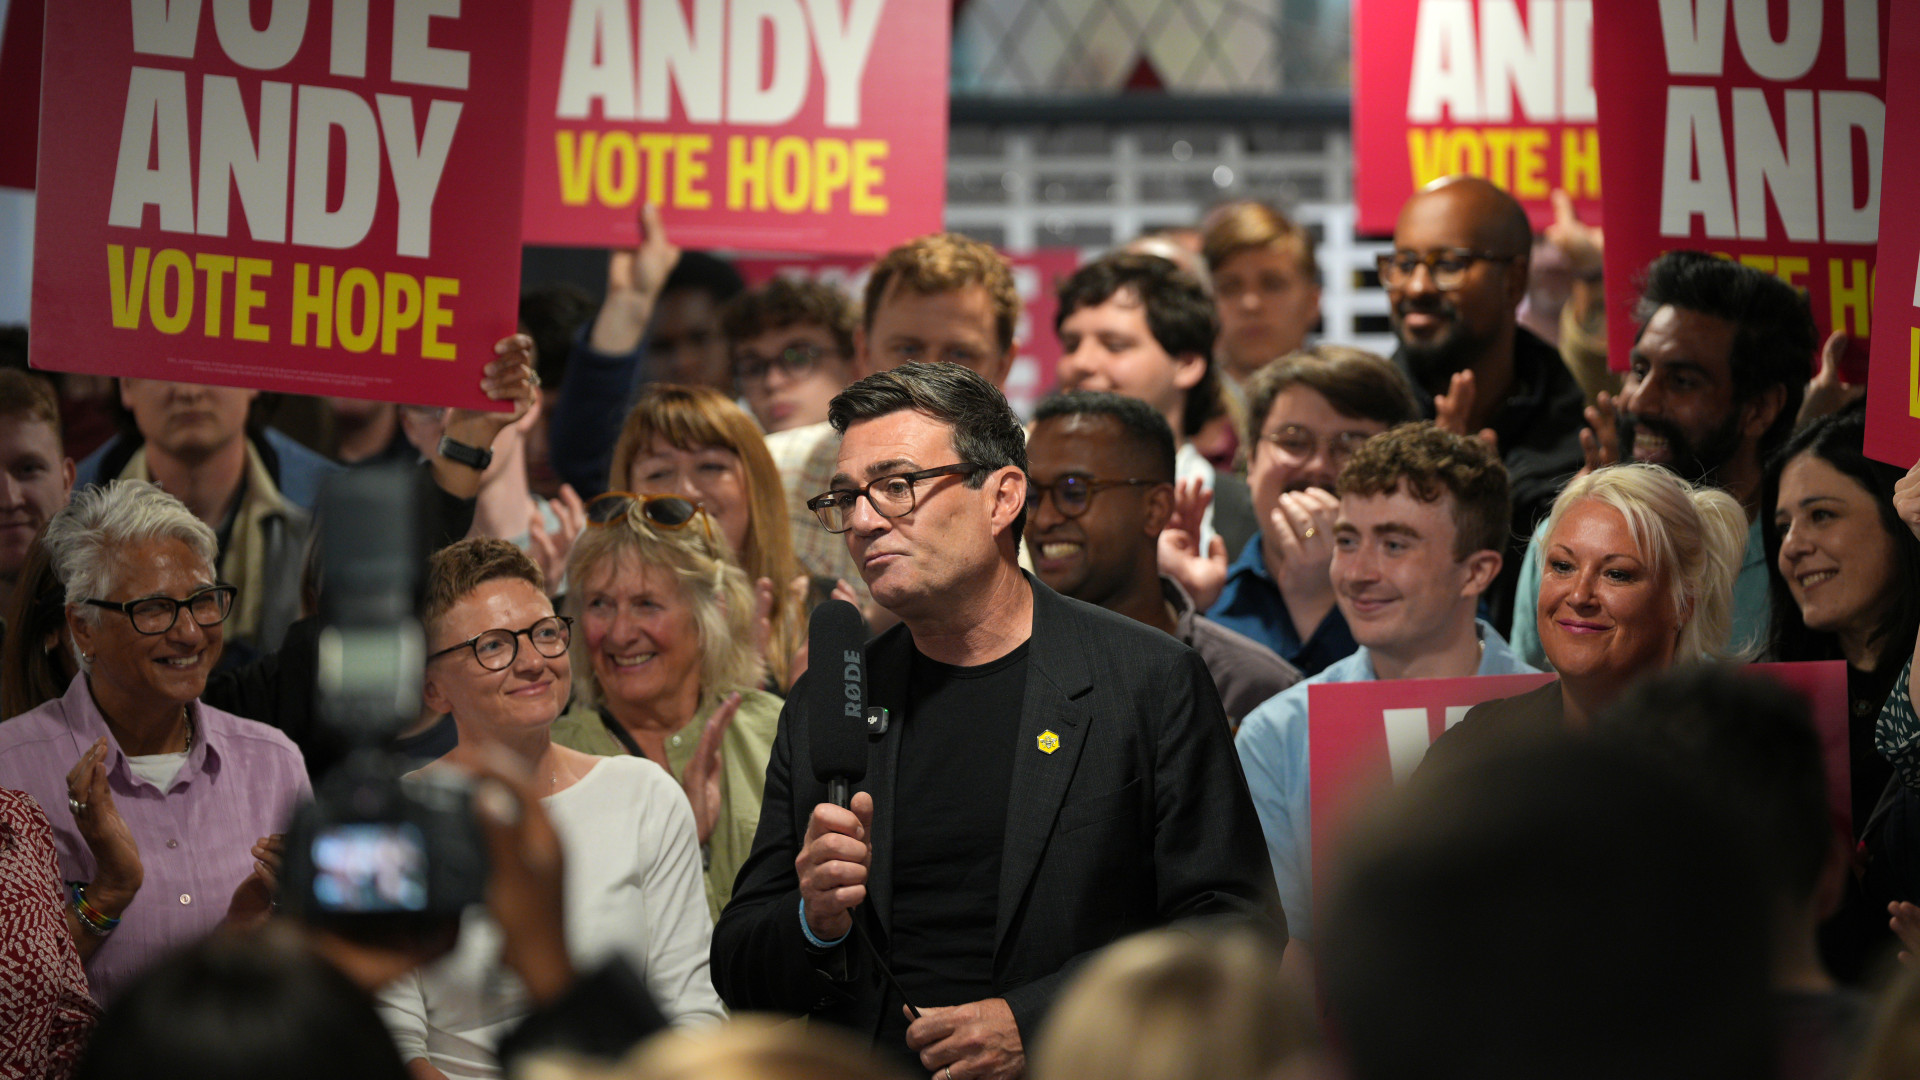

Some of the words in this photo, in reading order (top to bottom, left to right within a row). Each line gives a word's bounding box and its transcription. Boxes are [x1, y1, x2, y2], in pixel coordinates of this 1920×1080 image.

[555, 0, 883, 128] ANDY
[107, 66, 464, 259] ANDY
[555, 130, 712, 209] VOTE
[727, 135, 889, 215] HOPE
[1407, 127, 1549, 199] VOTE
[107, 244, 272, 342] VOTE
[291, 262, 460, 361] HOPE
[843, 649, 862, 718] RØDE
